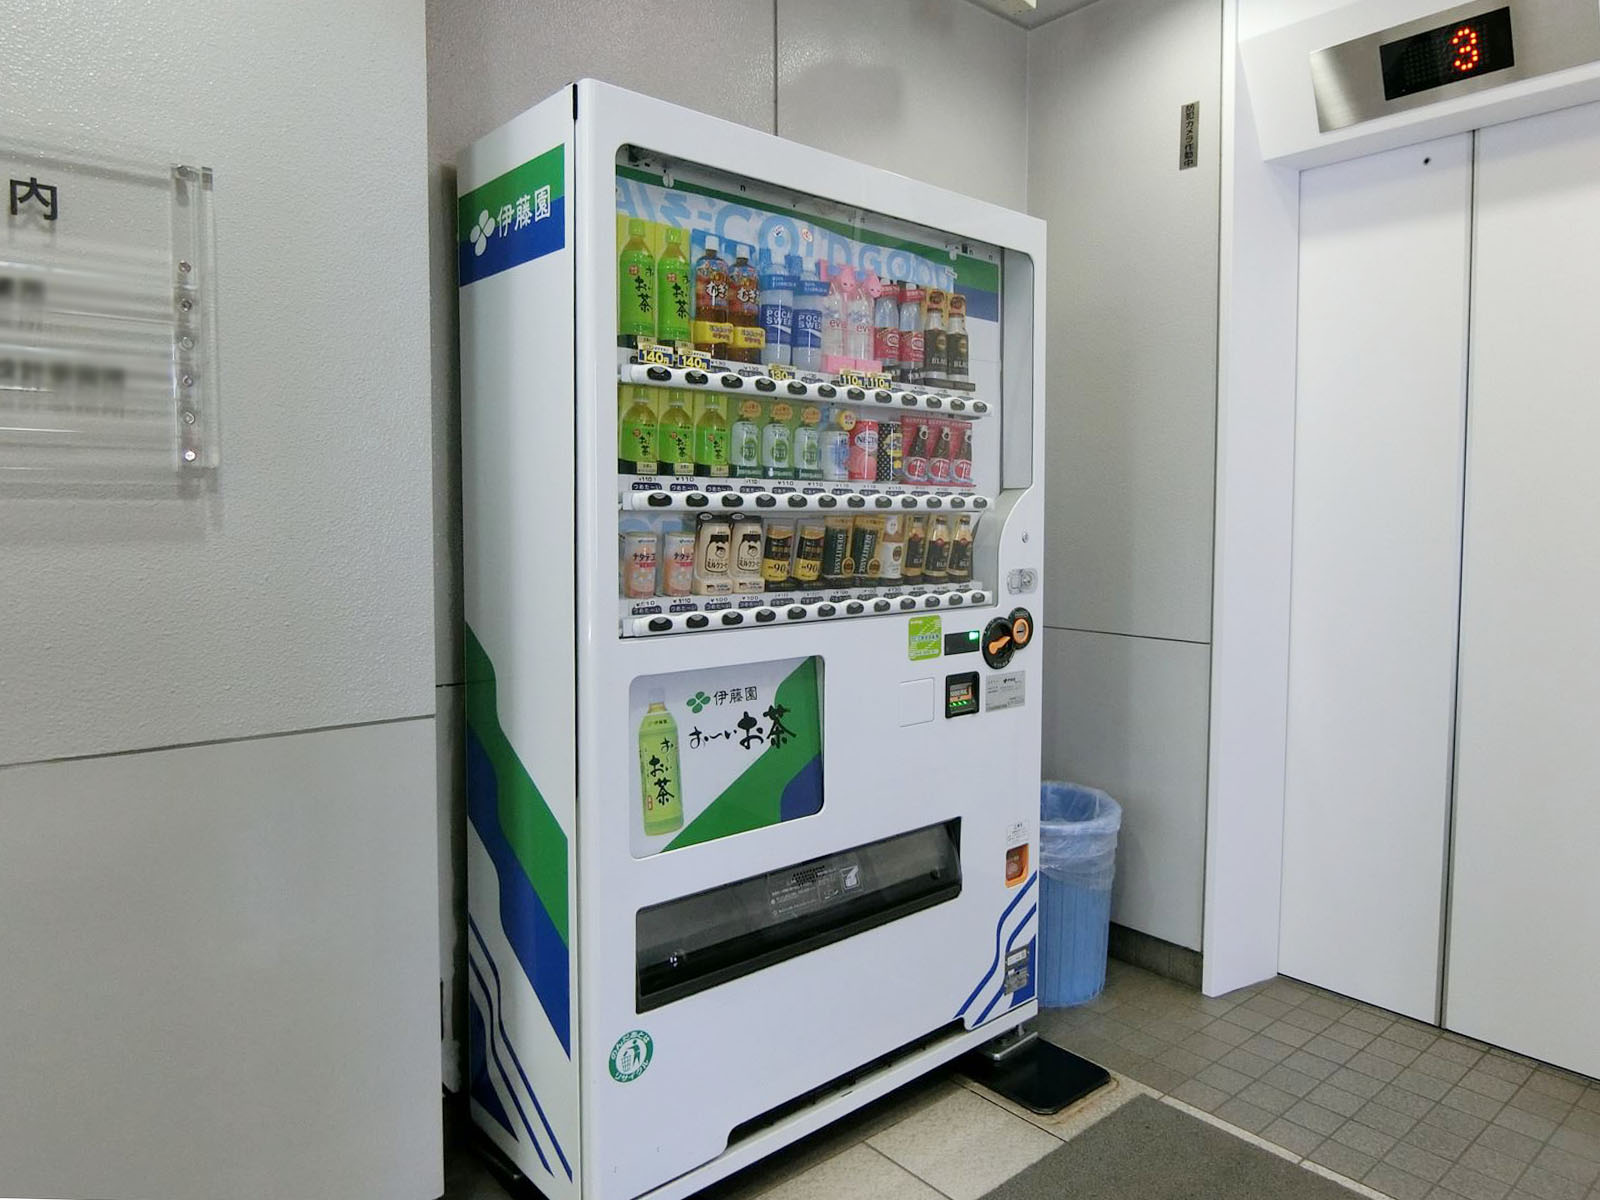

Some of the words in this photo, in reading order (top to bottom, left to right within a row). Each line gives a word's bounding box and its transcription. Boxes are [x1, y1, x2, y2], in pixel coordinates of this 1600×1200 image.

[1452, 27, 1478, 71] 3
[1184, 104, 1195, 167] 防犯カメラ作動中
[9, 177, 58, 221] 内
[496, 184, 551, 238] 伊藤園
[634, 275, 653, 313] お茶
[672, 282, 690, 319] お茶
[642, 350, 669, 364] 140円
[681, 355, 707, 369] 140円
[713, 685, 758, 707] 伊藤園
[648, 755, 675, 806] お茶
